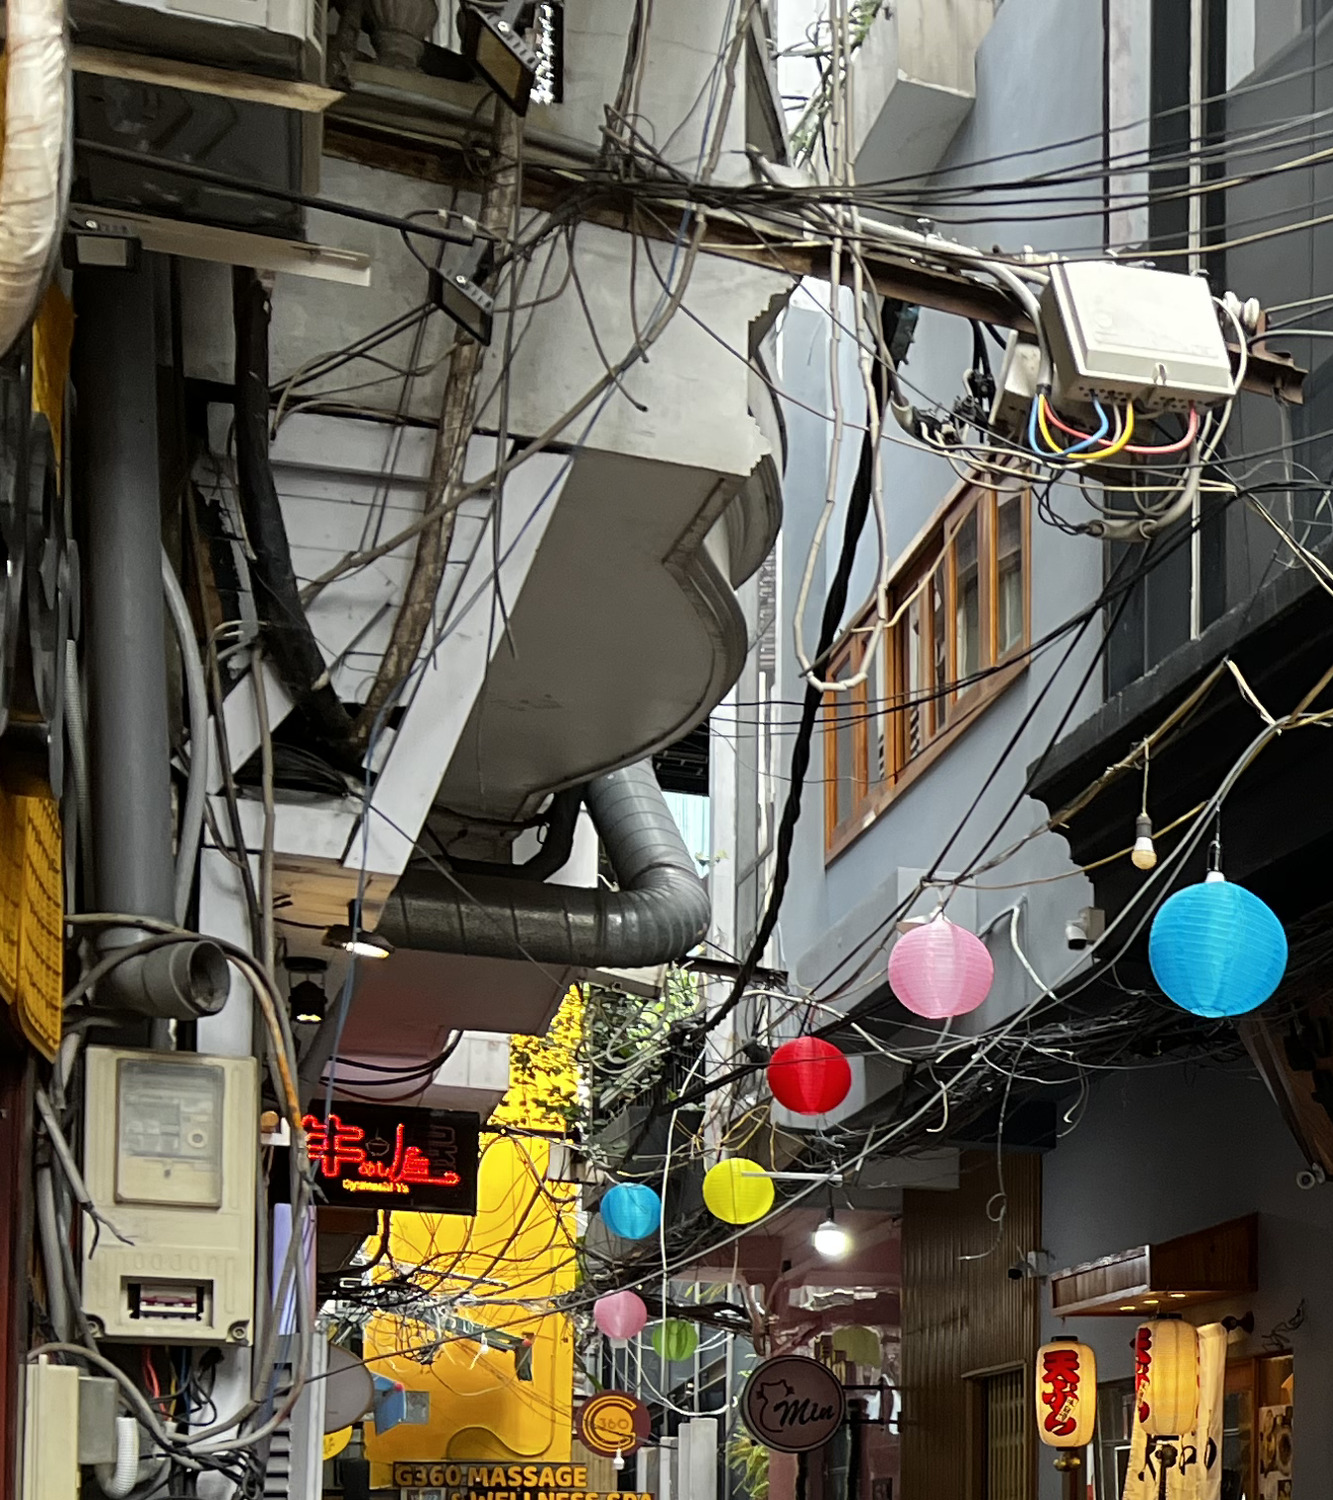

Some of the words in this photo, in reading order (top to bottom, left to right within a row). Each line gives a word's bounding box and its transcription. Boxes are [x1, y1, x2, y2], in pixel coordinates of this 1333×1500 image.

[773, 1398, 835, 1427] Min
[395, 1466, 462, 1488] G360
[468, 1466, 588, 1488] MASSAGE
